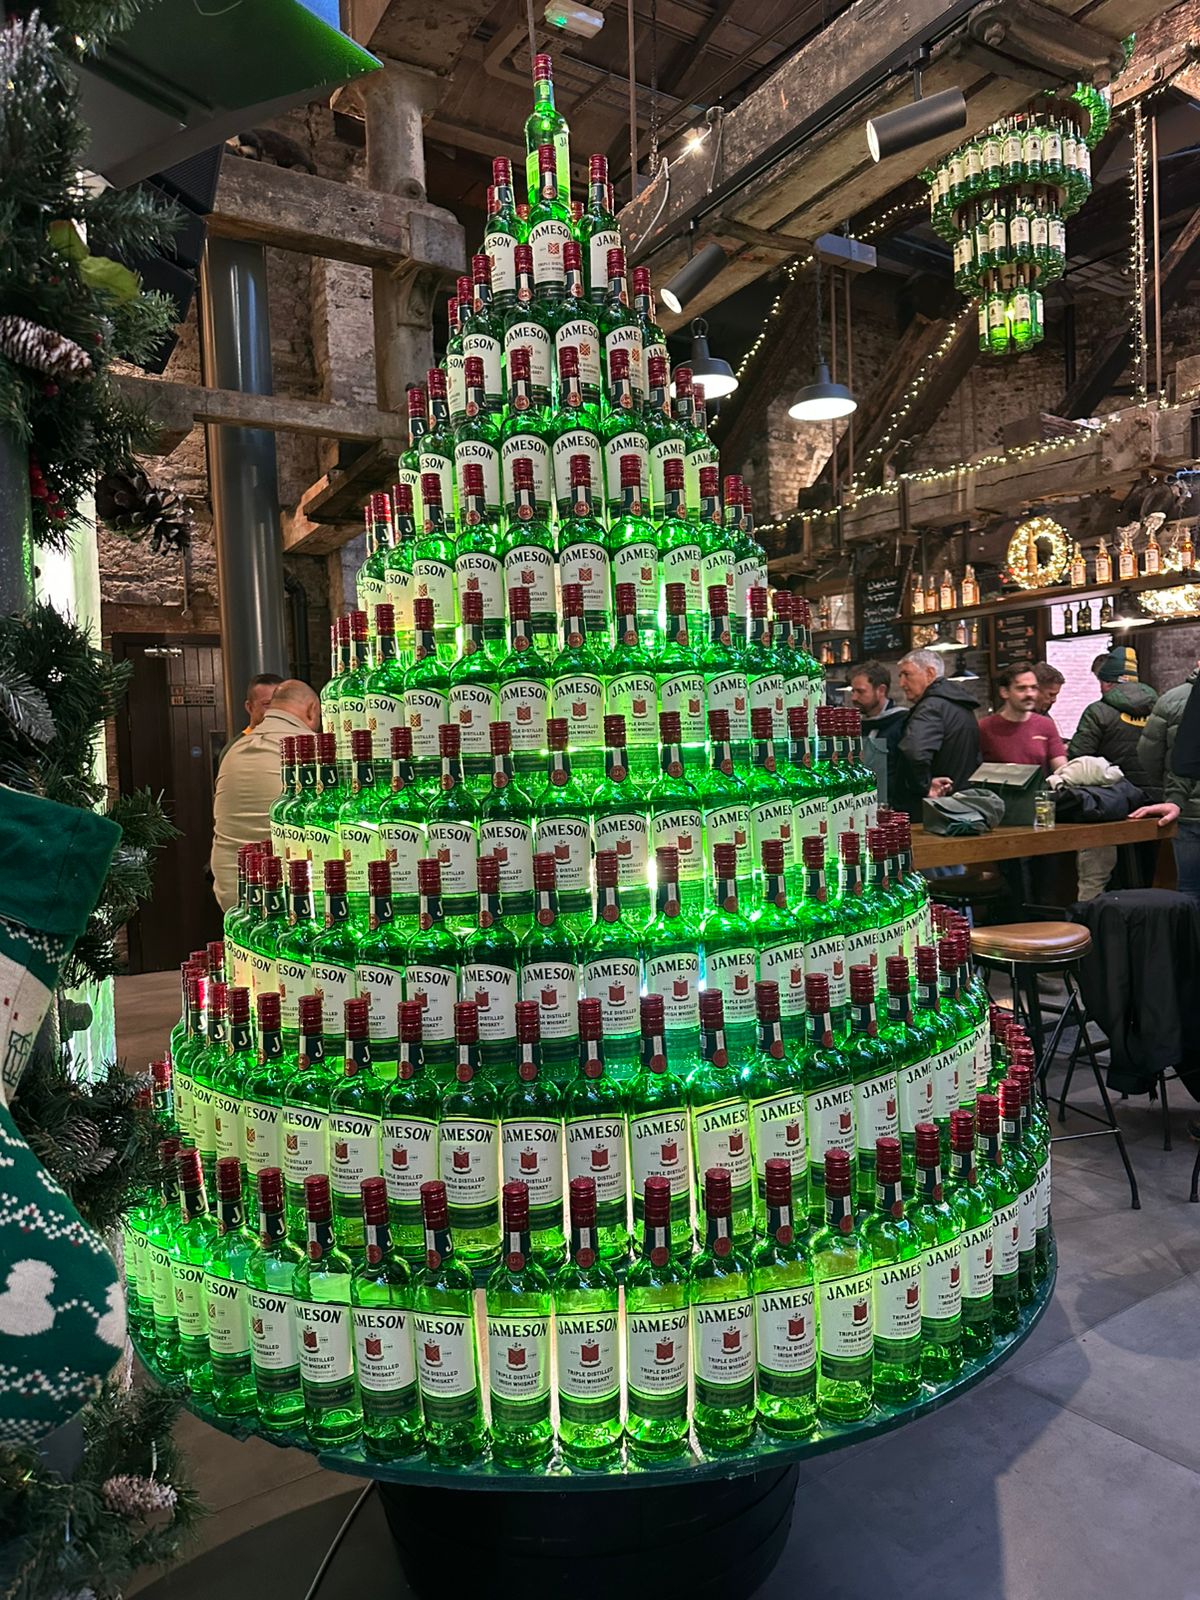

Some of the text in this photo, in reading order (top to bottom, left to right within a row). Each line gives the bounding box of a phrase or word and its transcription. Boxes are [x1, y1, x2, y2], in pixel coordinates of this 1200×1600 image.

[486, 236, 511, 248] ESON
[612, 332, 640, 345] JAME
[656, 443, 685, 459] JAME
[712, 810, 750, 829] JAMES
[341, 829, 371, 845] ESON
[761, 1100, 804, 1123] JAMES
[703, 1109, 748, 1132] JAMES
[205, 1280, 239, 1300] ESON
[826, 1277, 873, 1301] JAMES
[488, 1322, 548, 1338] JAMESON
